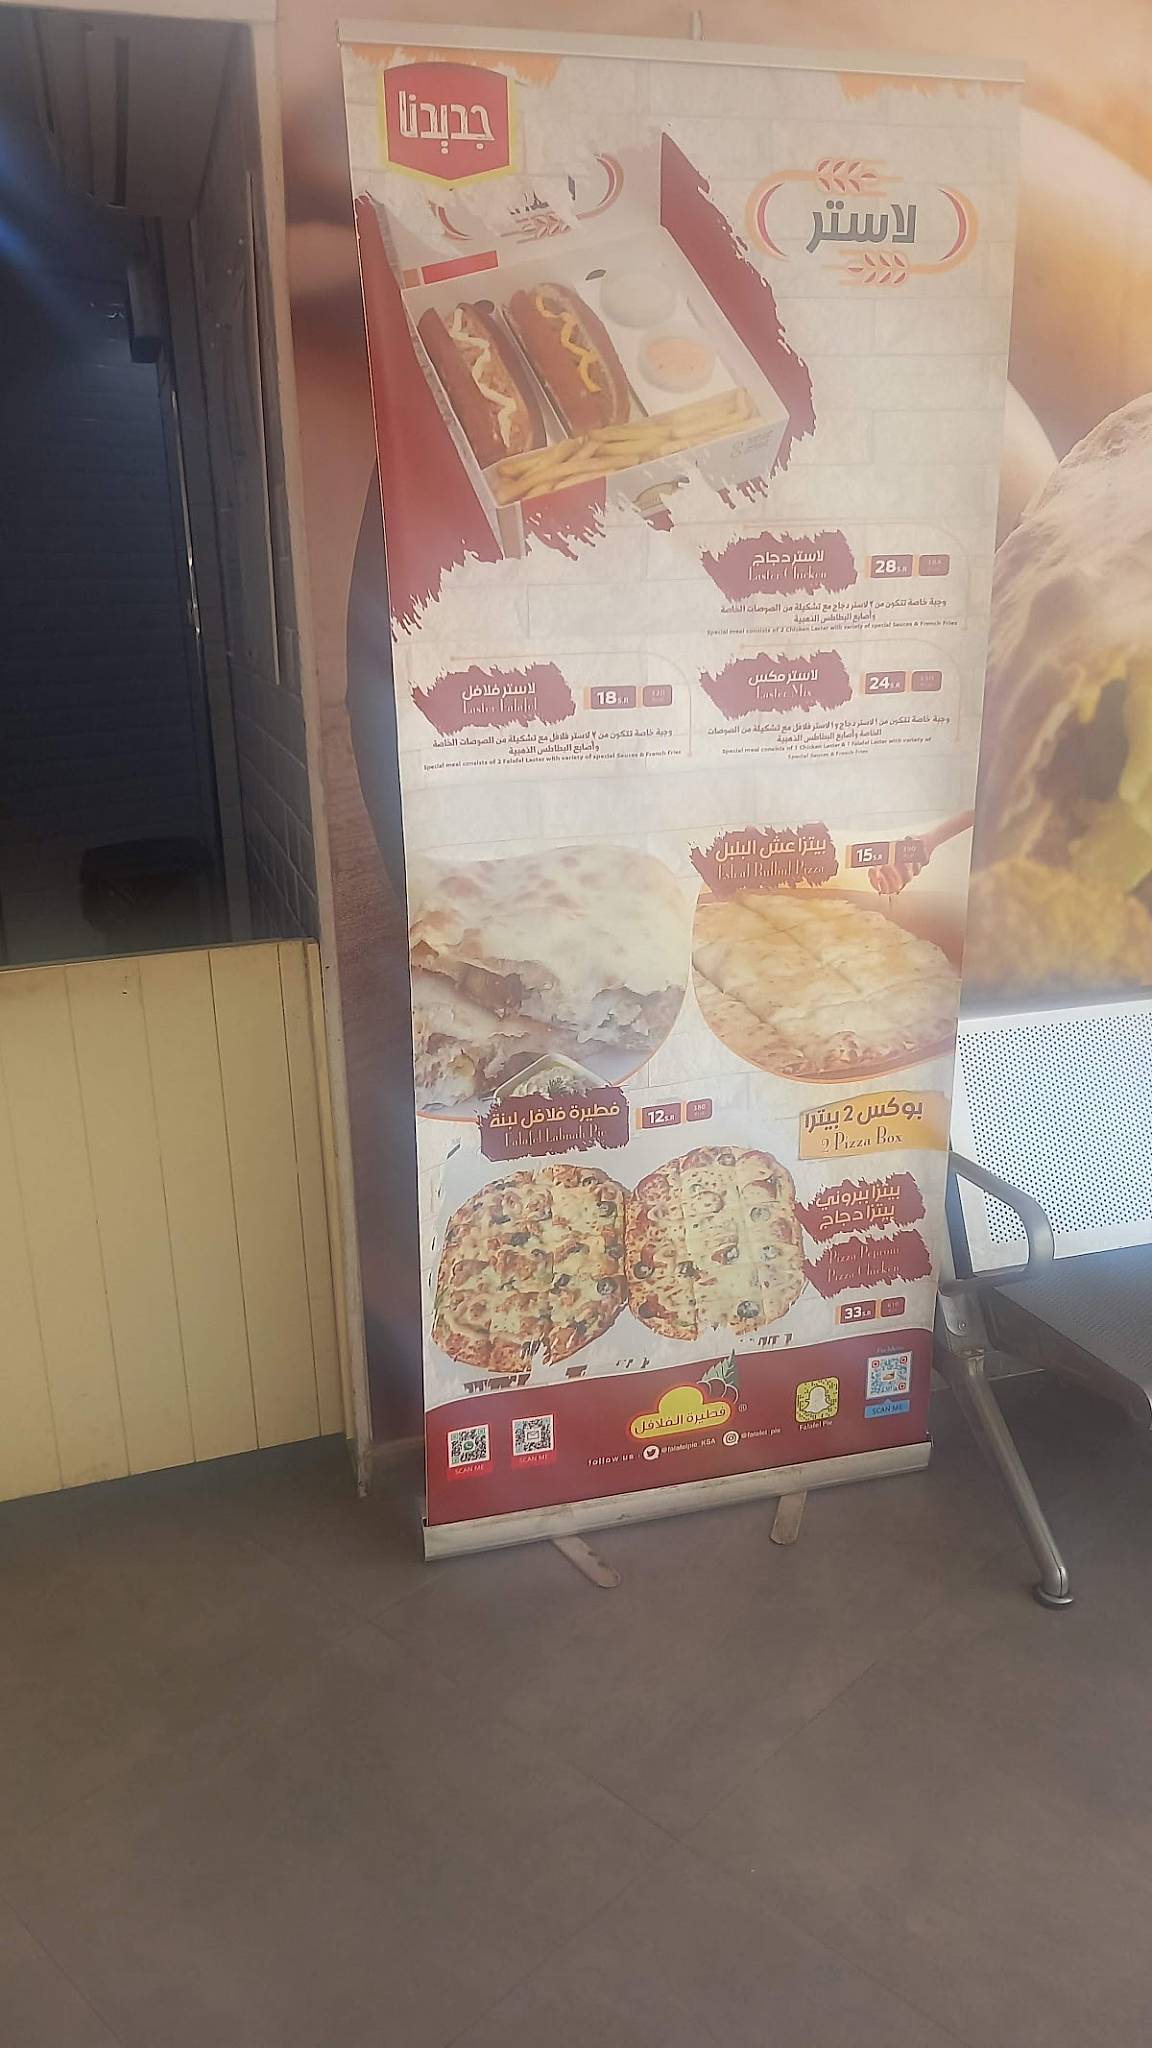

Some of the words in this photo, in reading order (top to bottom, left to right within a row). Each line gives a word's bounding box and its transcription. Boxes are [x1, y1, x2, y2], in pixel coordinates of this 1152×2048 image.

[399, 90, 495, 154] جديدنا
[806, 200, 916, 254] لاستر
[752, 552, 790, 566] دجاج
[792, 550, 824, 566] لاستر
[875, 560, 897, 574] 28
[794, 602, 821, 611] تشكيلة
[822, 604, 832, 612] مع
[832, 601, 850, 612] دجاج
[851, 600, 869, 610] لاستر
[875, 601, 884, 609] من
[885, 599, 907, 608] تتكون
[908, 598, 928, 606] خاصة
[929, 598, 947, 608] وجبة
[748, 670, 786, 686] مكس
[786, 669, 818, 685] لاستر
[869, 676, 890, 690] 24
[462, 684, 500, 700] فلافل
[502, 682, 536, 698] لاستر
[597, 691, 617, 705] 18
[840, 720, 856, 731] دجاج
[911, 715, 930, 723] خاصة
[932, 715, 950, 725] وجبة
[610, 729, 633, 739] تتكون
[634, 729, 654, 737] خاصة
[655, 728, 673, 737] وجبة
[753, 724, 780, 733] تشكيلة
[792, 723, 810, 732] فلافل
[433, 738, 458, 747] الخاصة
[460, 736, 494, 747] الصوصات
[508, 734, 537, 743] تشكيلة
[549, 731, 569, 743] فلافل
[570, 731, 590, 741] لاستر
[716, 840, 756, 862] البلبل
[760, 835, 795, 858] عش
[799, 836, 826, 856] بيتزا
[857, 848, 873, 863] 15
[796, 859, 824, 875] Pizza
[569, 1101, 620, 1122] فطيرة
[648, 1109, 665, 1124] 12
[843, 1104, 853, 1121] 2
[857, 1096, 923, 1125] بوكس
[490, 1111, 518, 1130] لبنة
[521, 1107, 566, 1129] فلافل
[821, 1138, 829, 1153] 2
[835, 1131, 871, 1150] Pizza
[876, 1125, 903, 1145] Box
[872, 1183, 900, 1202] بيتزا
[816, 1189, 869, 1211] ببروني
[820, 1209, 863, 1230] دجاج
[867, 1203, 894, 1222] بيتزا
[829, 1249, 856, 1264] Pizza
[828, 1268, 854, 1283] Pizza
[844, 1306, 862, 1319] 33
[687, 1406, 726, 1425] فطيرة
[872, 1405, 891, 1415] SCAN
[635, 1414, 684, 1434] الفلافل
[799, 1421, 822, 1431] Falafel
[519, 1455, 536, 1463] SCAN
[587, 1455, 619, 1467] follow
[455, 1467, 473, 1475] SCAN
